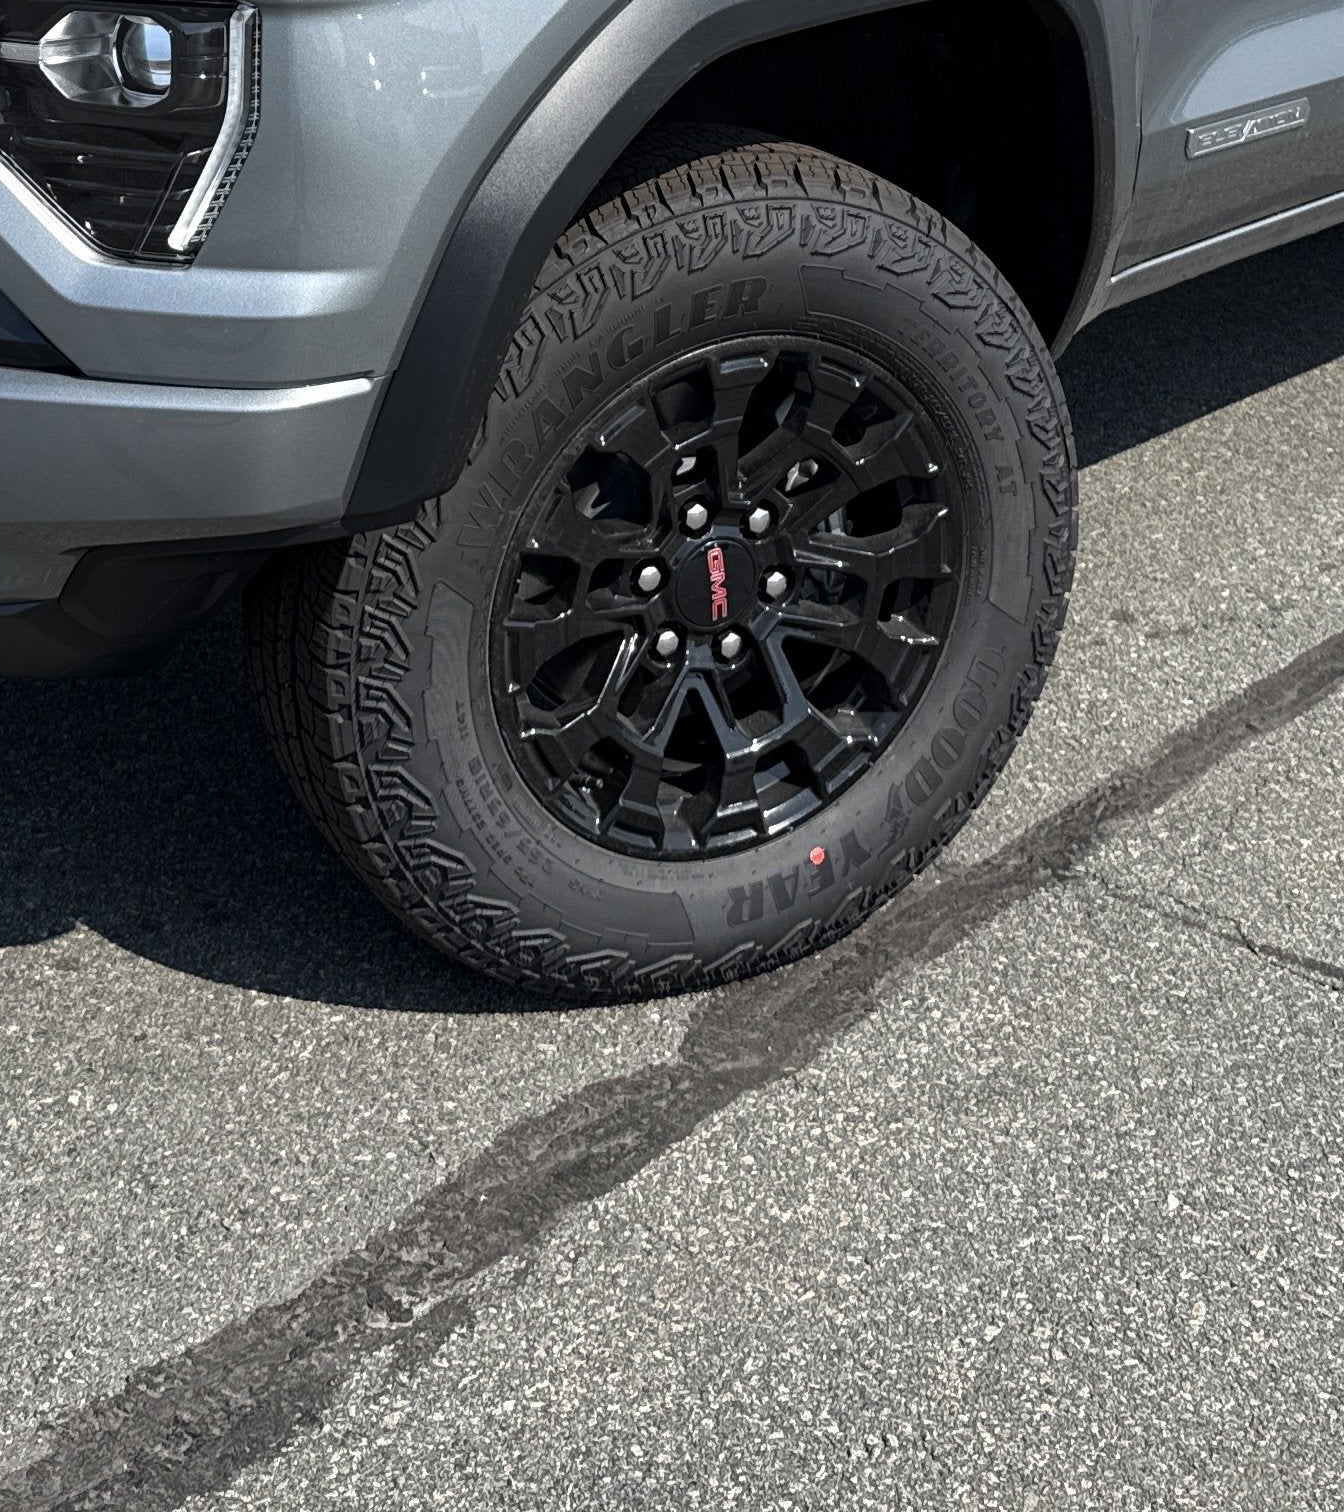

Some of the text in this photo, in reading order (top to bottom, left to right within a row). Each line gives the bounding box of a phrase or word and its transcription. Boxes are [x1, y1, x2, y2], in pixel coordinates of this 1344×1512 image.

[458, 276, 768, 550] WRANGLER
[902, 310, 1004, 442] TERRITORY
[994, 464, 1018, 497] AT
[707, 548, 728, 621] GMC
[726, 648, 1006, 928] GOODYEAR
